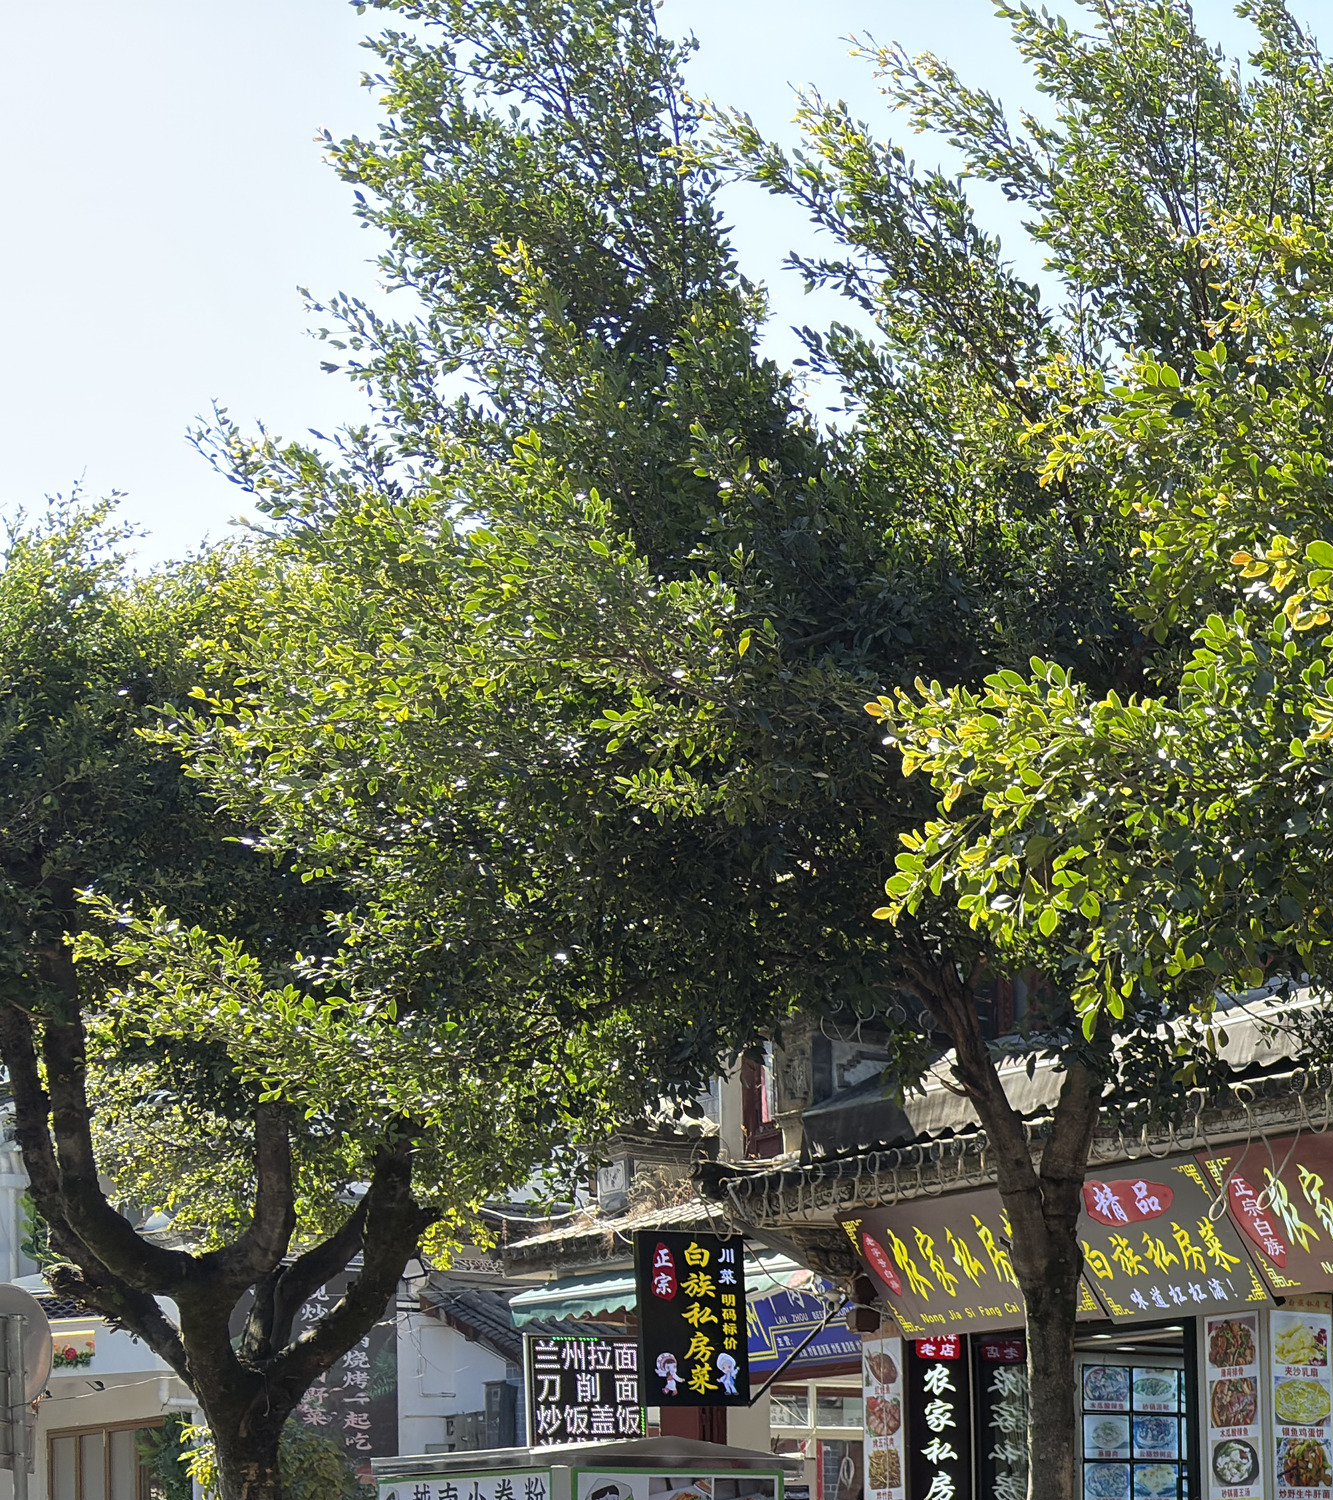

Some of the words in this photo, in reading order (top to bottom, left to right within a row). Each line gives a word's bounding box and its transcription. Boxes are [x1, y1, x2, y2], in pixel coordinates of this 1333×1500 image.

[1092, 1180, 1162, 1222] 精品
[1230, 1178, 1286, 1256] 正宗白族
[887, 1208, 1019, 1301] 农家私房
[1081, 1216, 1240, 1280] 白族私房菜
[654, 1248, 673, 1295] 正宗
[718, 1248, 736, 1285] 川菜
[680, 1241, 718, 1395] 白族私房菜
[721, 1294, 737, 1350] 明码标价
[775, 1314, 787, 1324] LAN
[793, 1313, 808, 1323] ZHOU
[920, 1311, 945, 1325] Nong
[949, 1307, 962, 1320] Jia
[965, 1307, 975, 1318] Si
[980, 1304, 1001, 1320] Fang
[1005, 1302, 1020, 1314] Cai
[535, 1340, 638, 1372] 兰州拉面
[920, 1343, 956, 1356] 老店
[537, 1373, 638, 1402] 刀削面
[1284, 1367, 1319, 1377] 夹沙乳扇
[537, 1406, 640, 1435] 炒饭盖饭
[1279, 1489, 1330, 1500] 炒野生牛肝菌
